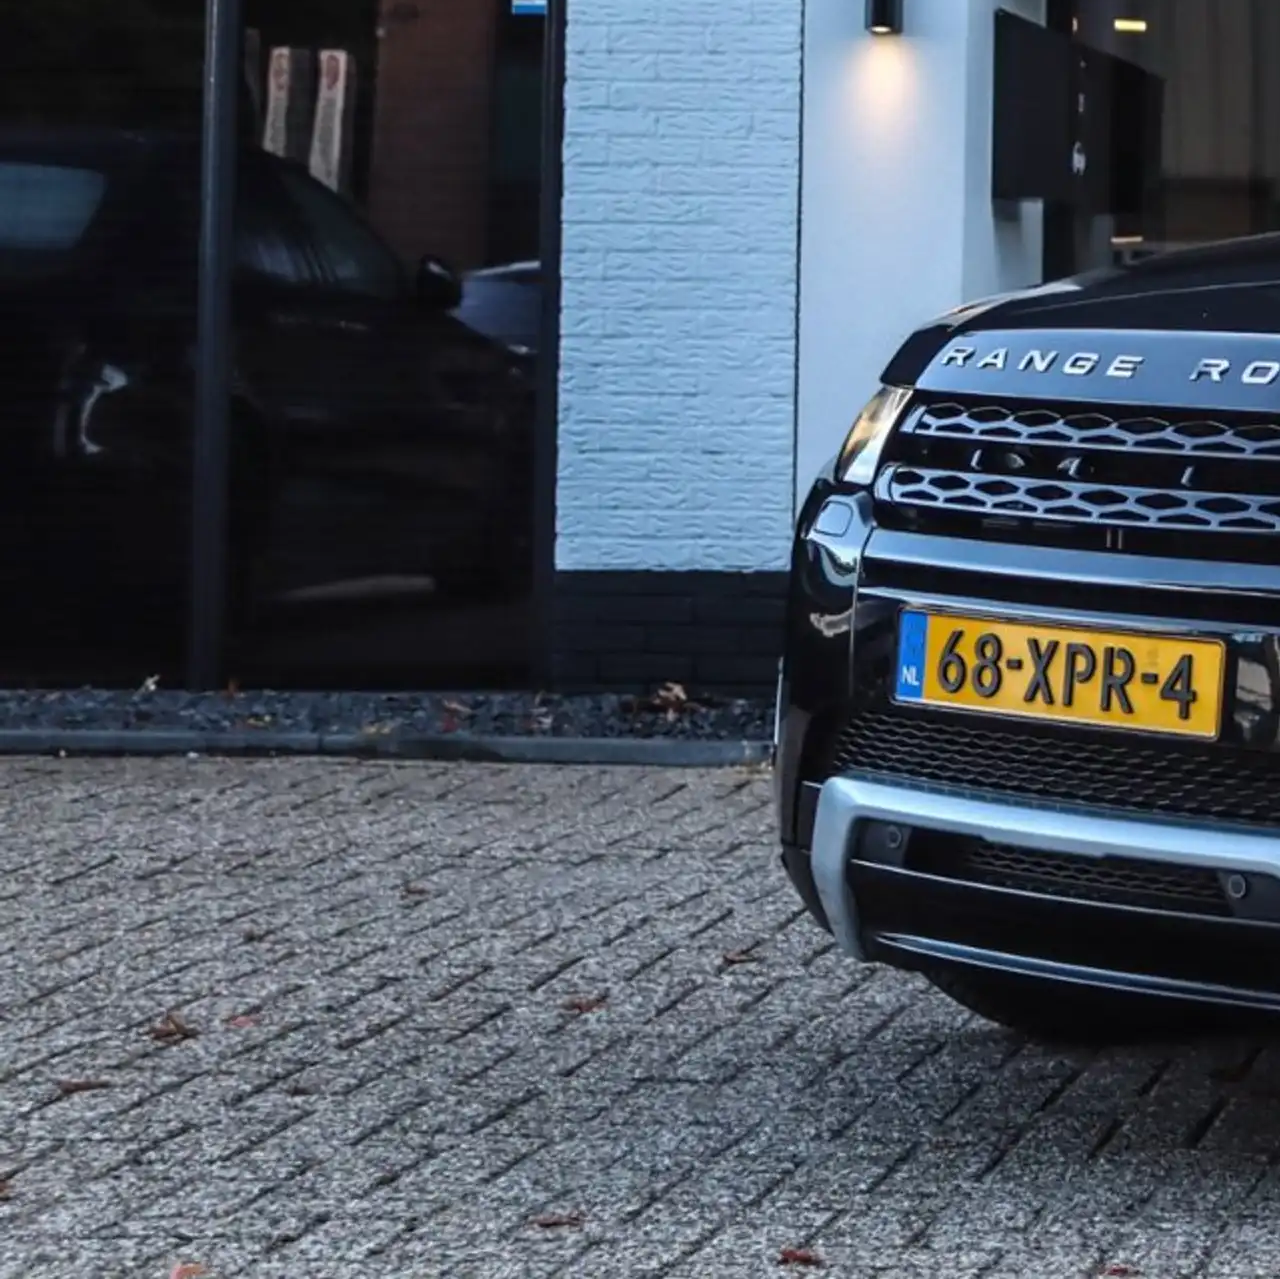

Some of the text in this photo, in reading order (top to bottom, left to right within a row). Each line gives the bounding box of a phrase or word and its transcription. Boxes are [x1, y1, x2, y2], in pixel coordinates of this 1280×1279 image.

[941, 346, 1142, 378] RANGE
[902, 665, 920, 686] NL
[938, 630, 1197, 719] 68-XPR-4
